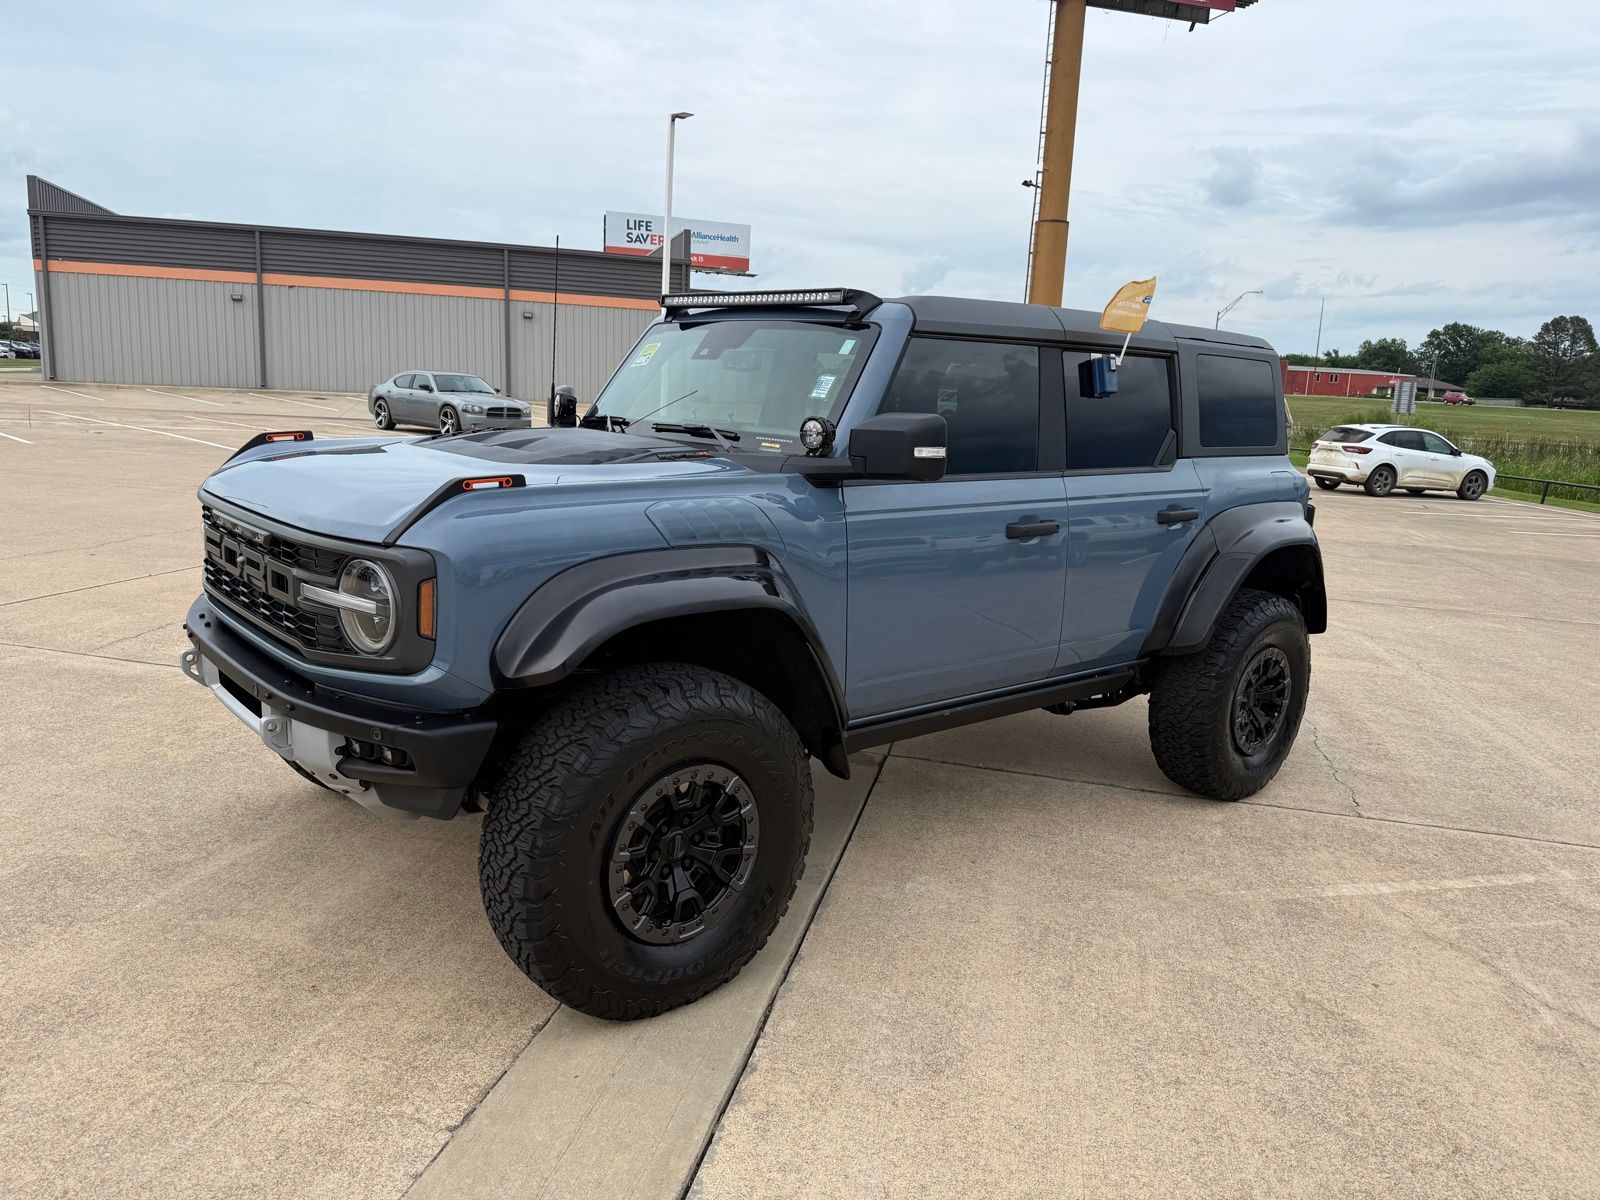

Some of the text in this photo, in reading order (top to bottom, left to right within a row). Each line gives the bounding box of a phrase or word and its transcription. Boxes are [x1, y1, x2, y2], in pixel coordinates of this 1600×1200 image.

[626, 218, 653, 232] LIFE
[626, 231, 664, 246] SAVER
[691, 231, 739, 244] AllianceHealth
[203, 525, 295, 605] FORD
